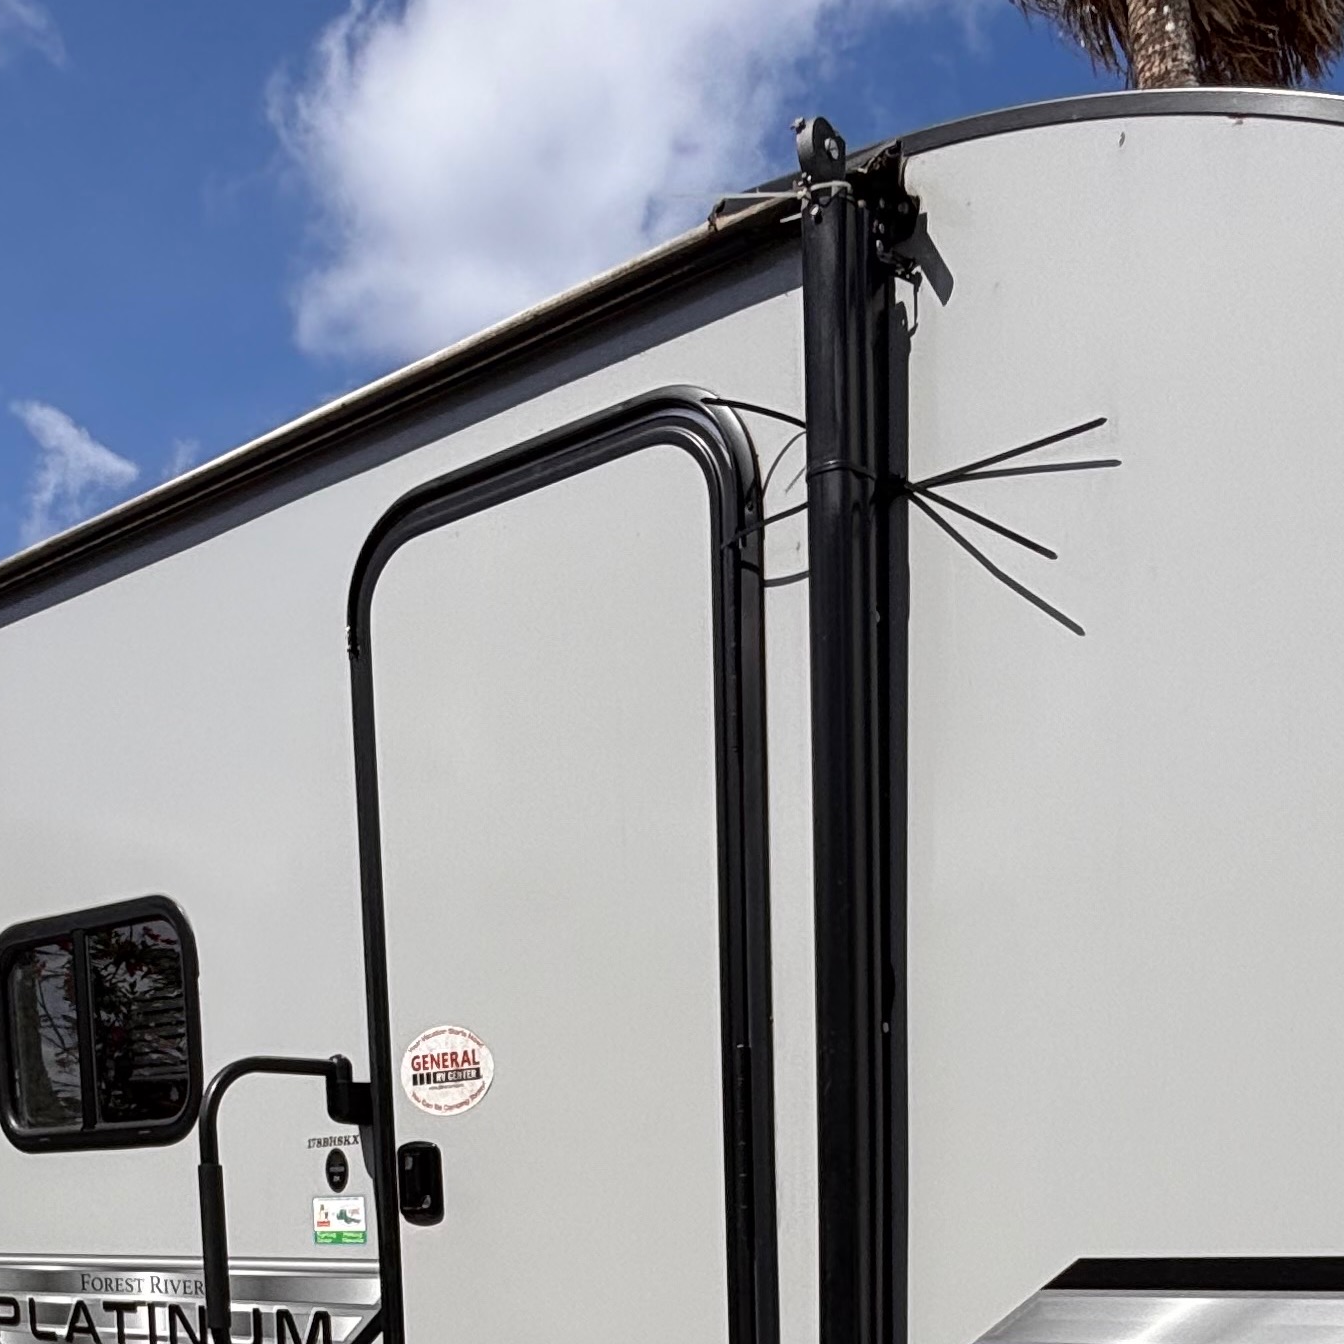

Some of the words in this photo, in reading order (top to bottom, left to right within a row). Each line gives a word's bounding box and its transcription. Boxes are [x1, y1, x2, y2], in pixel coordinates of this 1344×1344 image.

[411, 1048, 480, 1071] GENERAL
[435, 1072, 446, 1082] RV
[447, 1069, 477, 1080] CENTER
[307, 1135, 360, 1149] 178BHSKX
[81, 1273, 144, 1293] FOREST
[150, 1275, 205, 1296] RIVER
